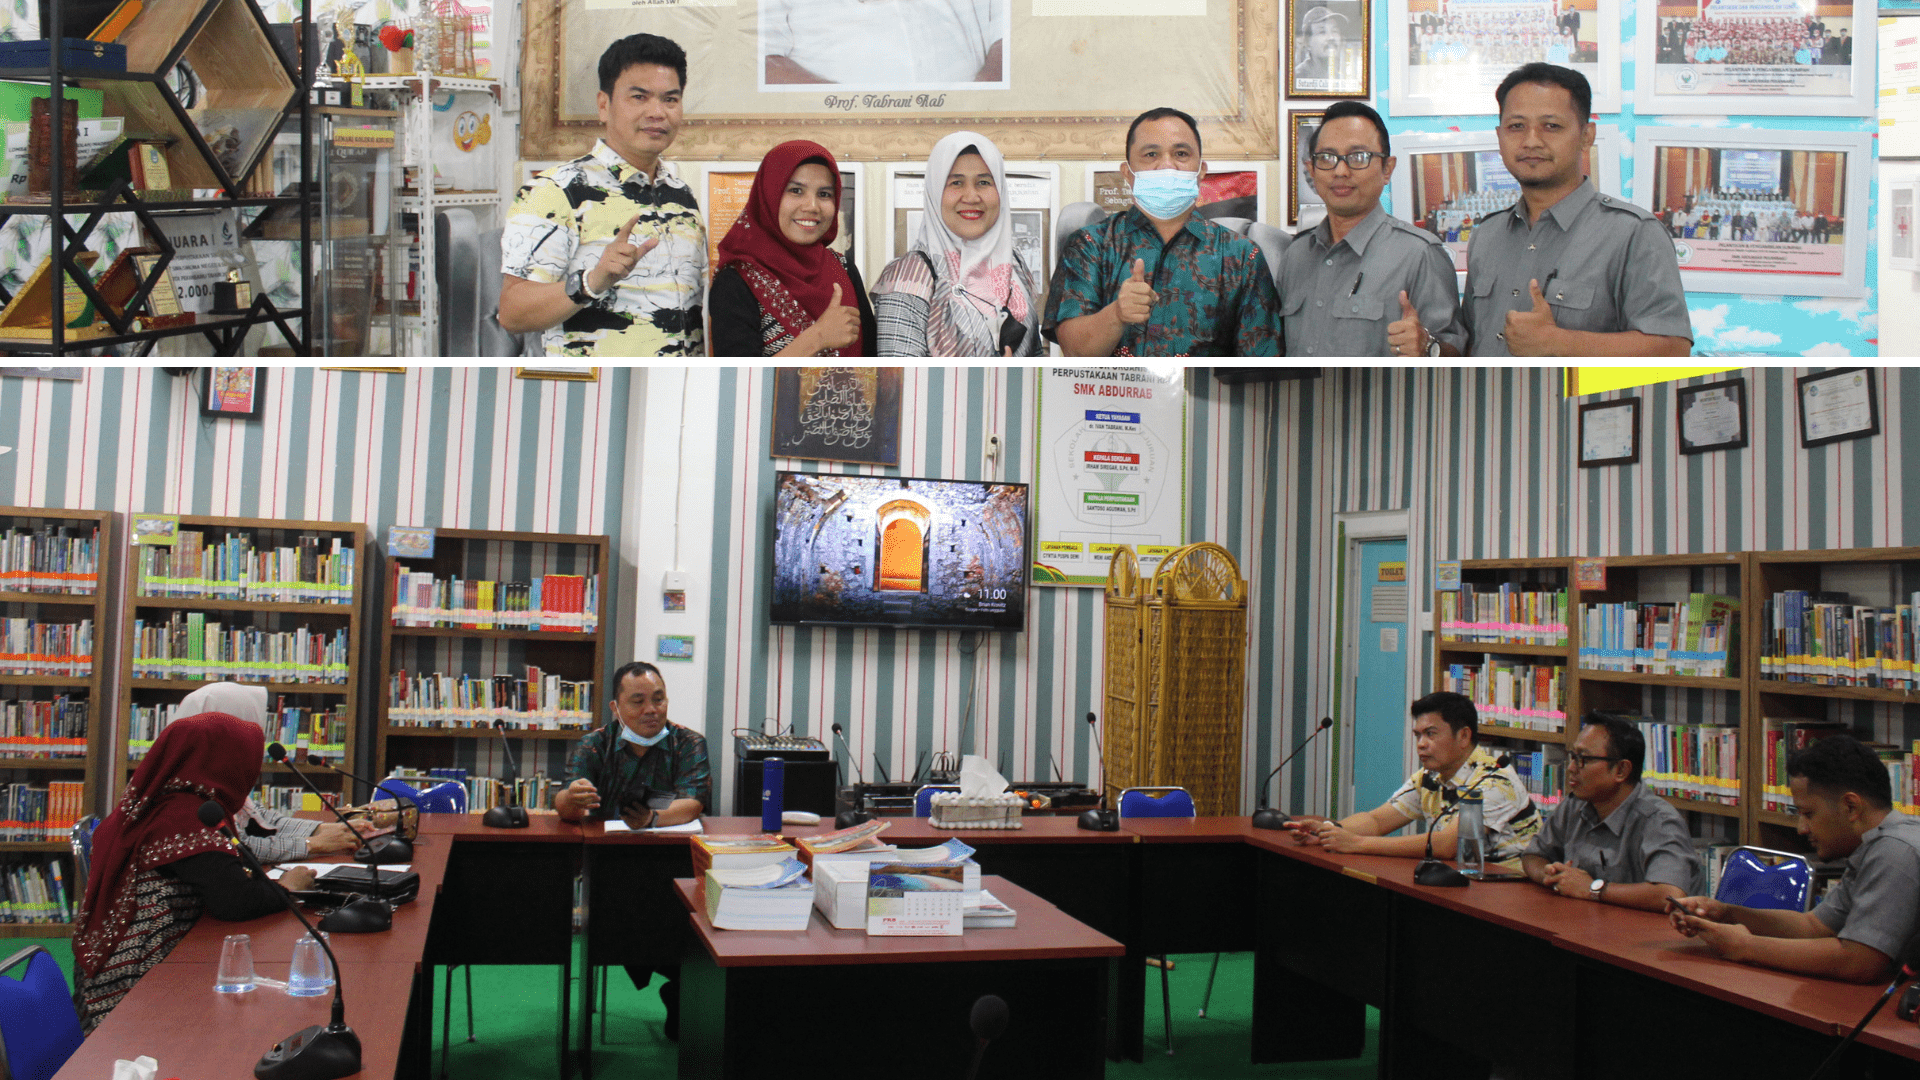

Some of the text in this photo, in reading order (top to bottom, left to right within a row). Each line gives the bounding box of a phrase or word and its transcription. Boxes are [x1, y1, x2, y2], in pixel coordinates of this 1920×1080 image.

[824, 93, 947, 111] Prof. Tabrani Rab
[10, 174, 27, 185] Rp
[1099, 187, 1119, 195] Prof.
[1053, 368, 1118, 381] PERPUSTAKAAN
[1121, 373, 1155, 384] TABRANI
[1073, 383, 1152, 399] SMK ABDURRAB
[1381, 567, 1404, 576] TOILET
[978, 588, 1007, 600] 11.00
